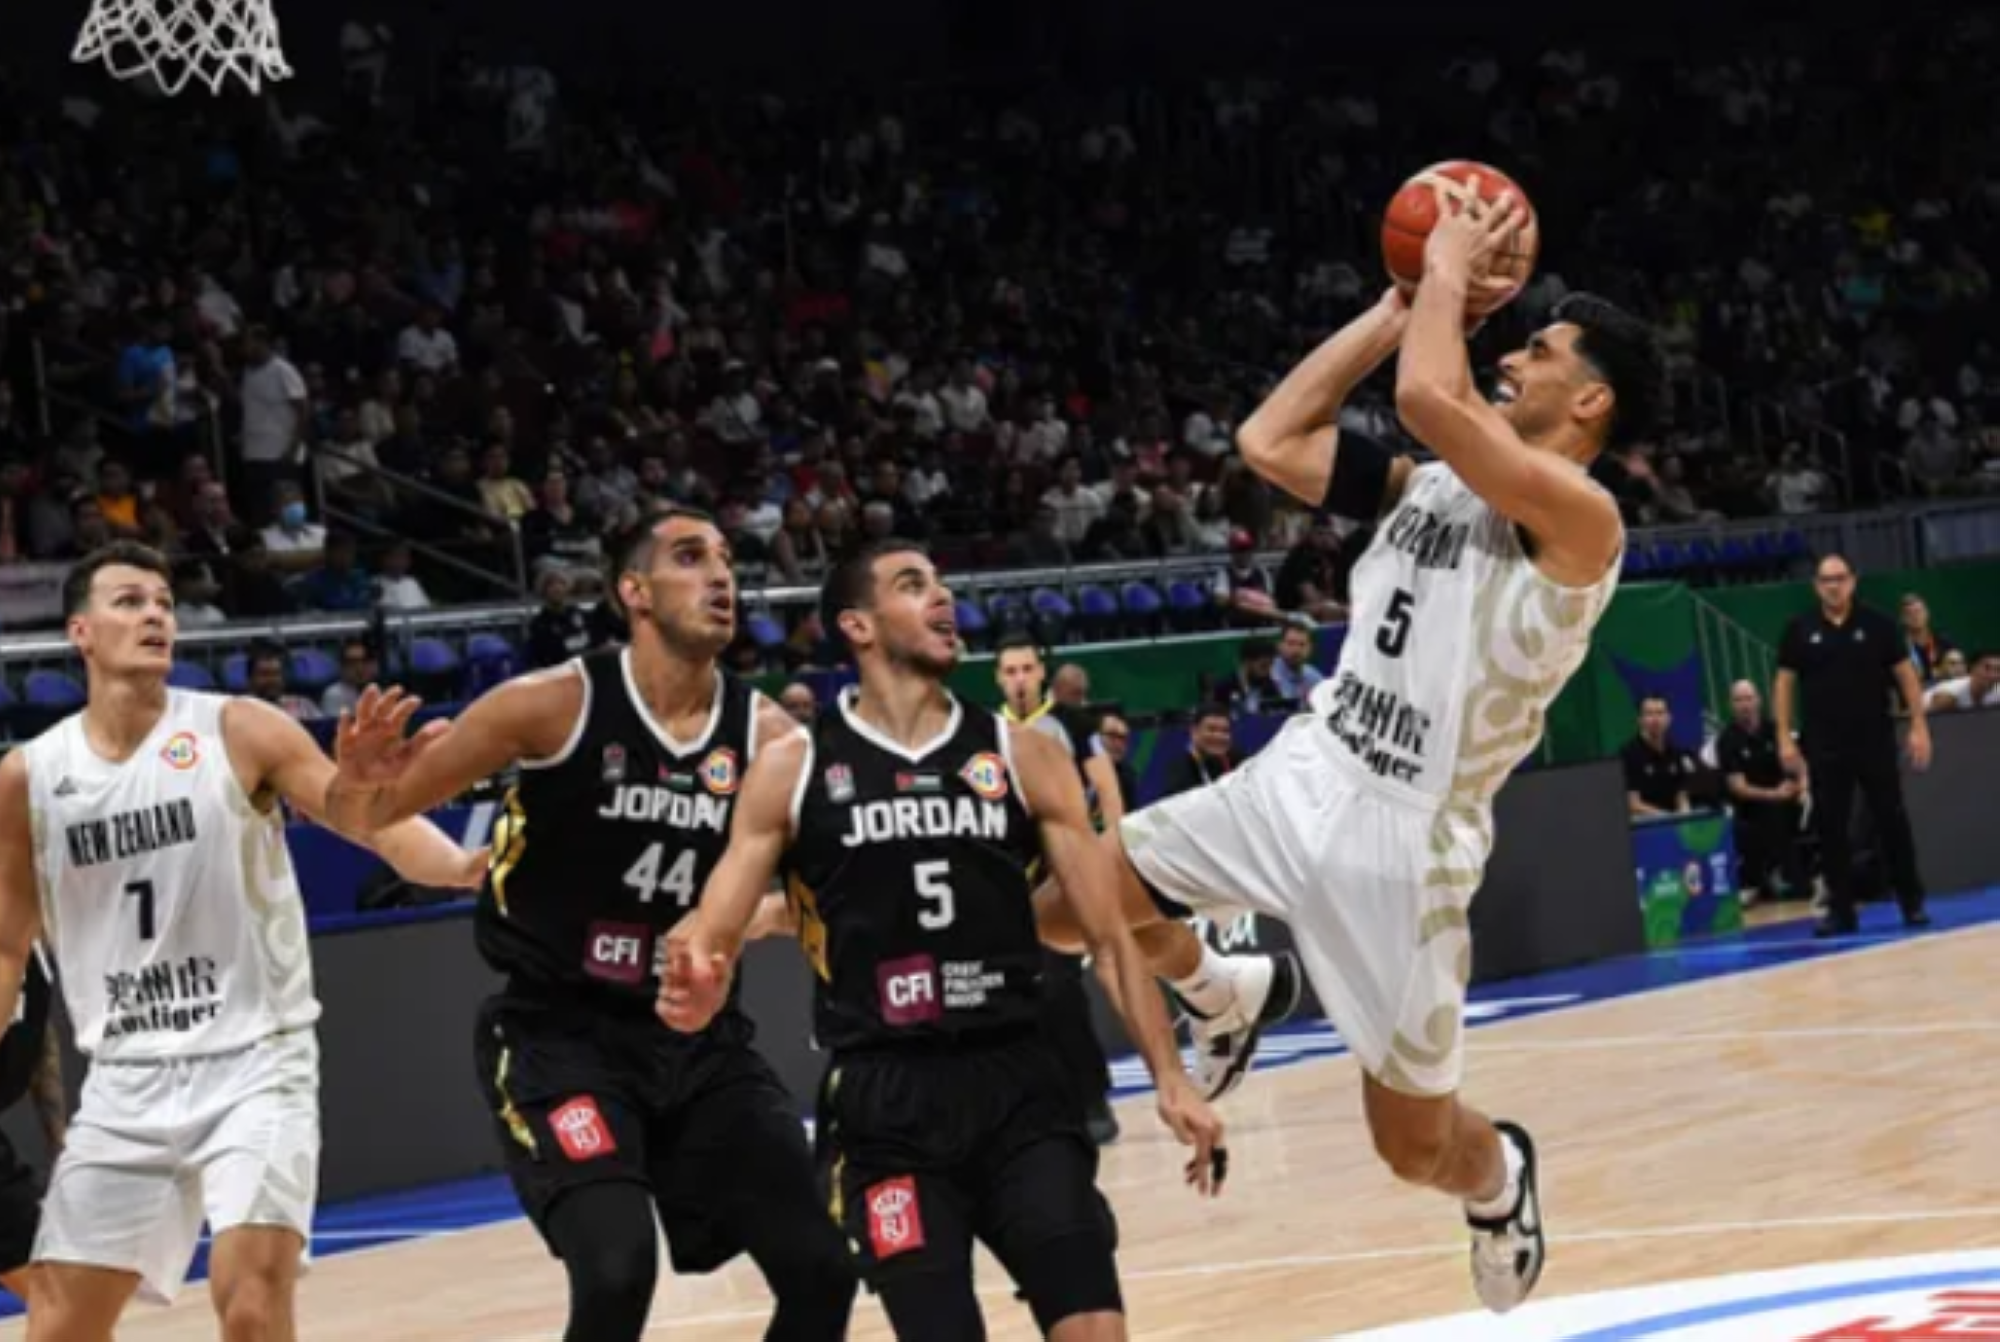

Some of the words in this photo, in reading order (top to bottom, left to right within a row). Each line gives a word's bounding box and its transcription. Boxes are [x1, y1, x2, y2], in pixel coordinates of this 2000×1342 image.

[1376, 587, 1415, 659] 5
[66, 818, 111, 868] NEW
[112, 797, 196, 859] ZEALAND
[841, 796, 1007, 847] JORDAN
[622, 842, 696, 906] 44
[913, 860, 955, 931] 5
[593, 933, 640, 965] CFI
[887, 970, 934, 1008] CFI
